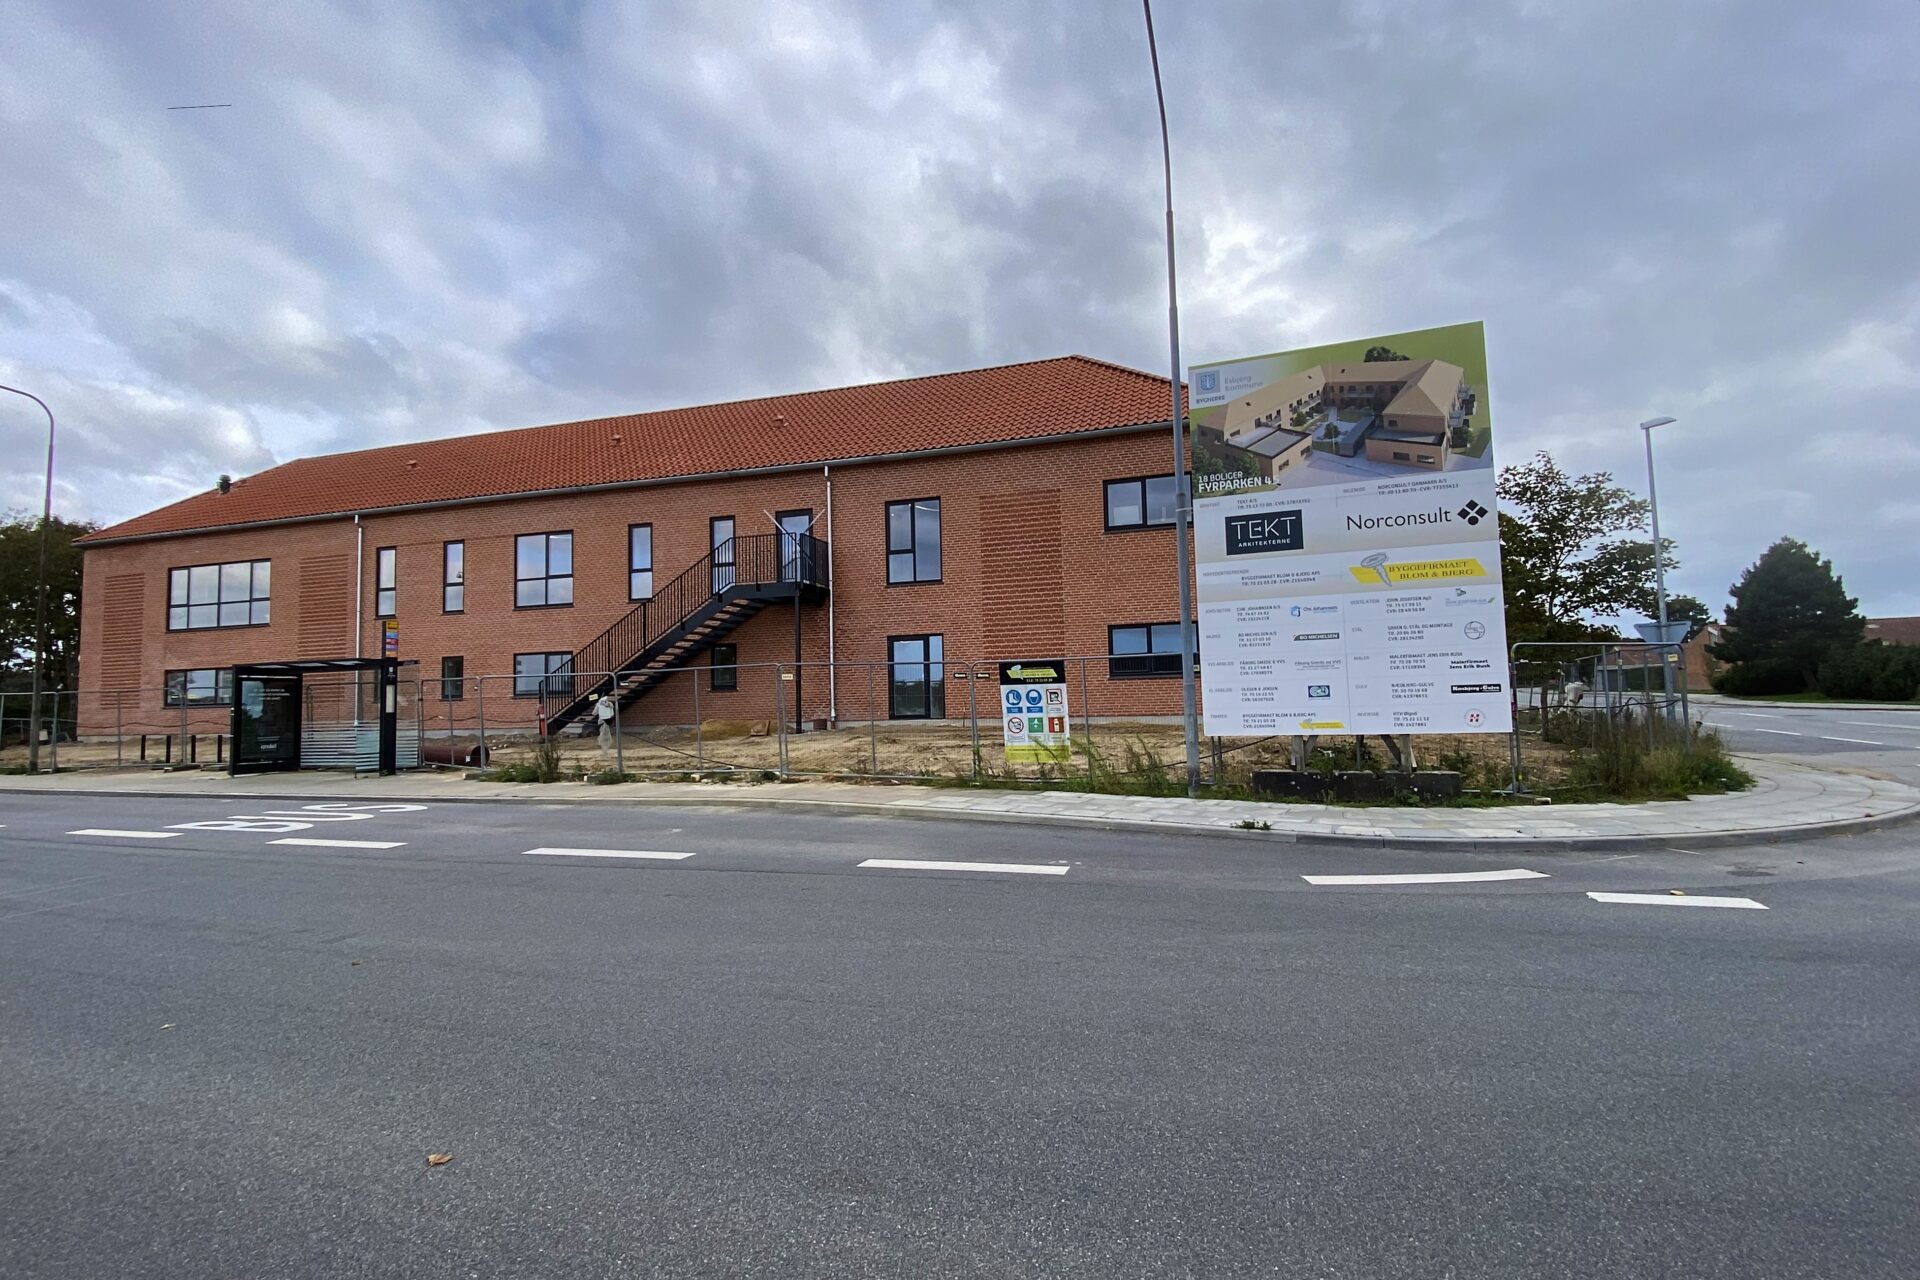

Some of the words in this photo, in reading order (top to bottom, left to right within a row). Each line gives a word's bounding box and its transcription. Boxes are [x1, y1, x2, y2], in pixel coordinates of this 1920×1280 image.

[1198, 476, 1262, 493] FYRPARKEN
[1199, 475, 1208, 483] 18
[1210, 471, 1243, 482] BOLIGER
[1347, 506, 1452, 531] Norconsult
[1231, 516, 1296, 540] TEKT
[1238, 538, 1290, 548] ARKITEKTERNE
[1389, 560, 1469, 573] BYGGEFIRMAET
[1400, 571, 1429, 580] BLOM
[1442, 568, 1473, 577] BJERG
[163, 803, 428, 832] BUS
